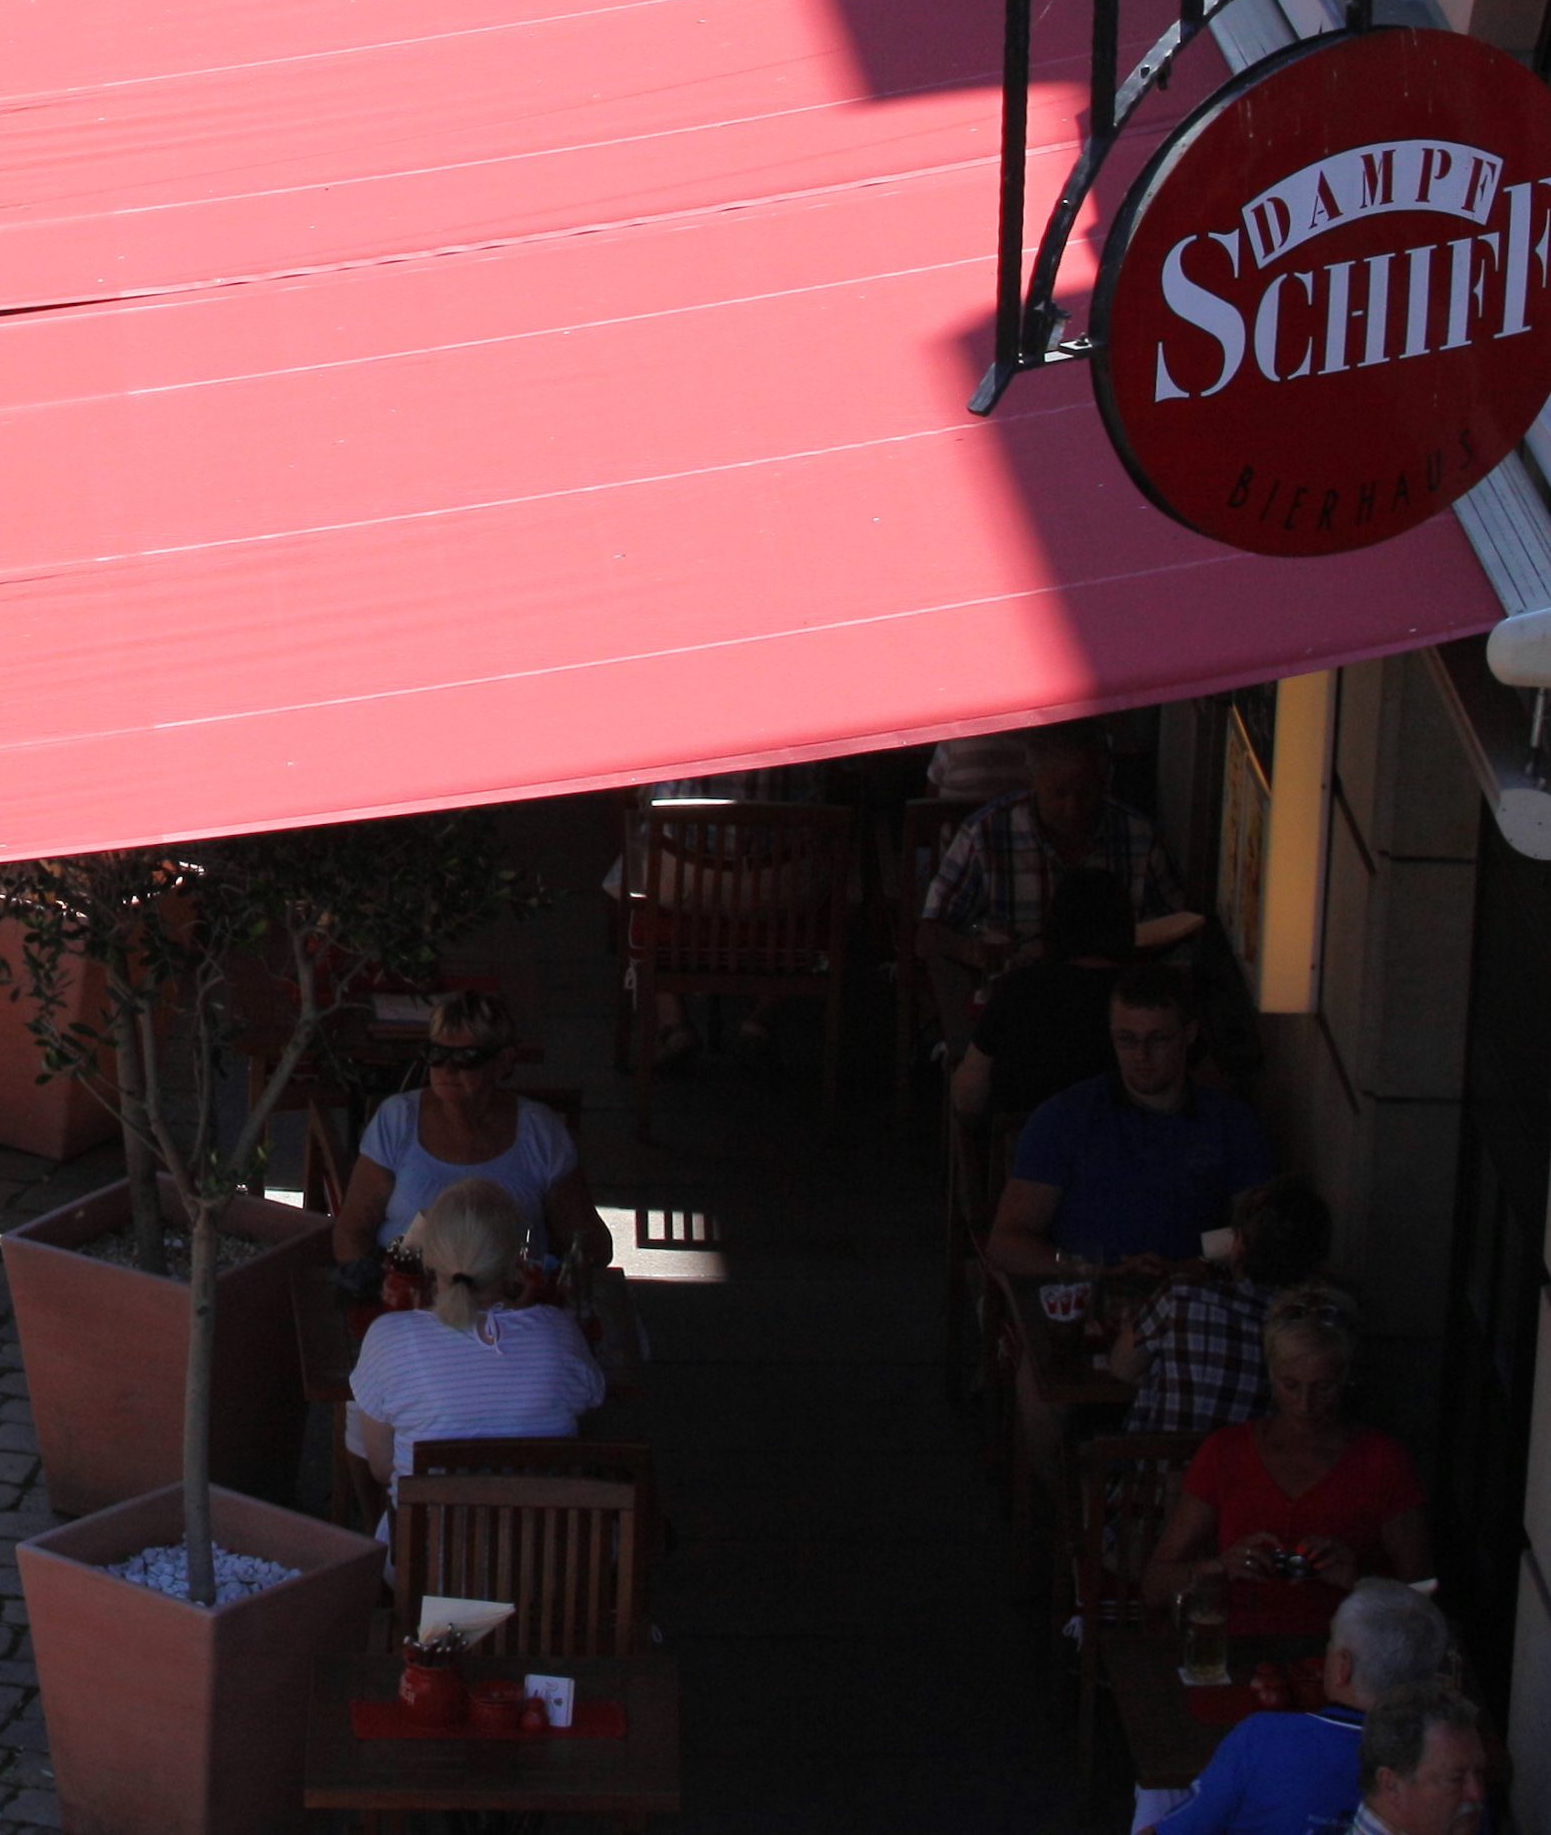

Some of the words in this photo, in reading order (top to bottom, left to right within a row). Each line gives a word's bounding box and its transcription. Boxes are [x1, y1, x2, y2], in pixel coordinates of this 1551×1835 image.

[1250, 146, 1499, 260] DAMPF
[1153, 178, 1551, 403] SCHIFF
[1226, 428, 1474, 532] BIERHAUS
